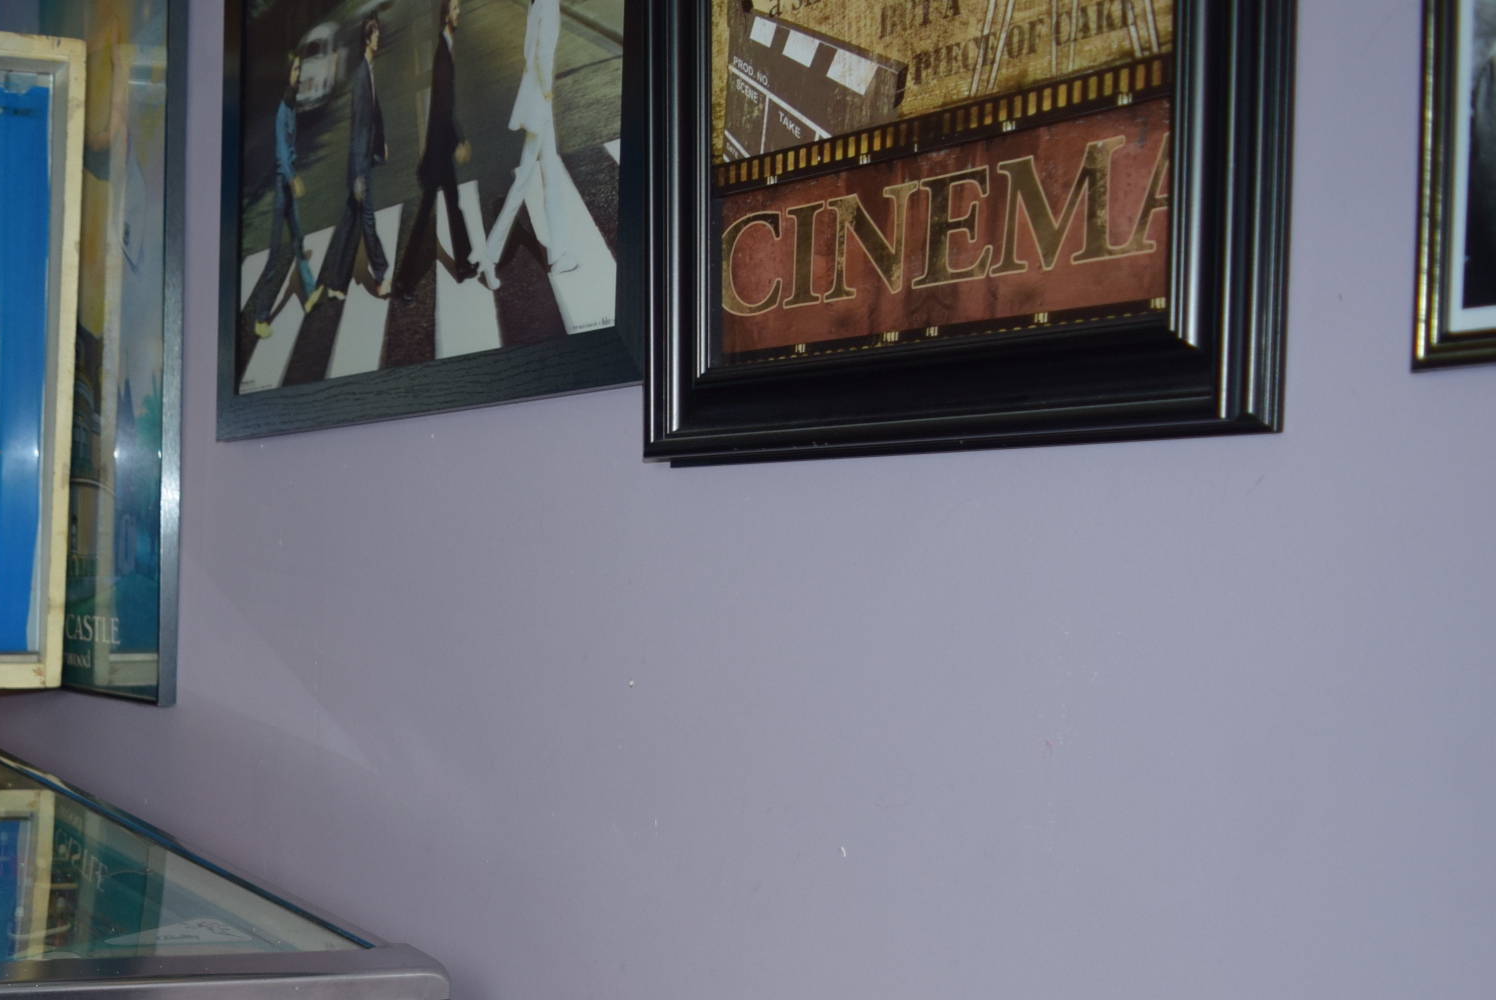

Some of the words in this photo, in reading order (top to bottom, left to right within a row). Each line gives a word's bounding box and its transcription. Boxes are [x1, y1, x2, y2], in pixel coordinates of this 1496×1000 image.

[1006, 18, 1044, 60] OF
[733, 55, 756, 78] PROD.
[756, 70, 770, 88] NO.
[735, 79, 759, 104] SCENE
[777, 110, 802, 139] TAKE
[66, 613, 122, 646] CASTLE
